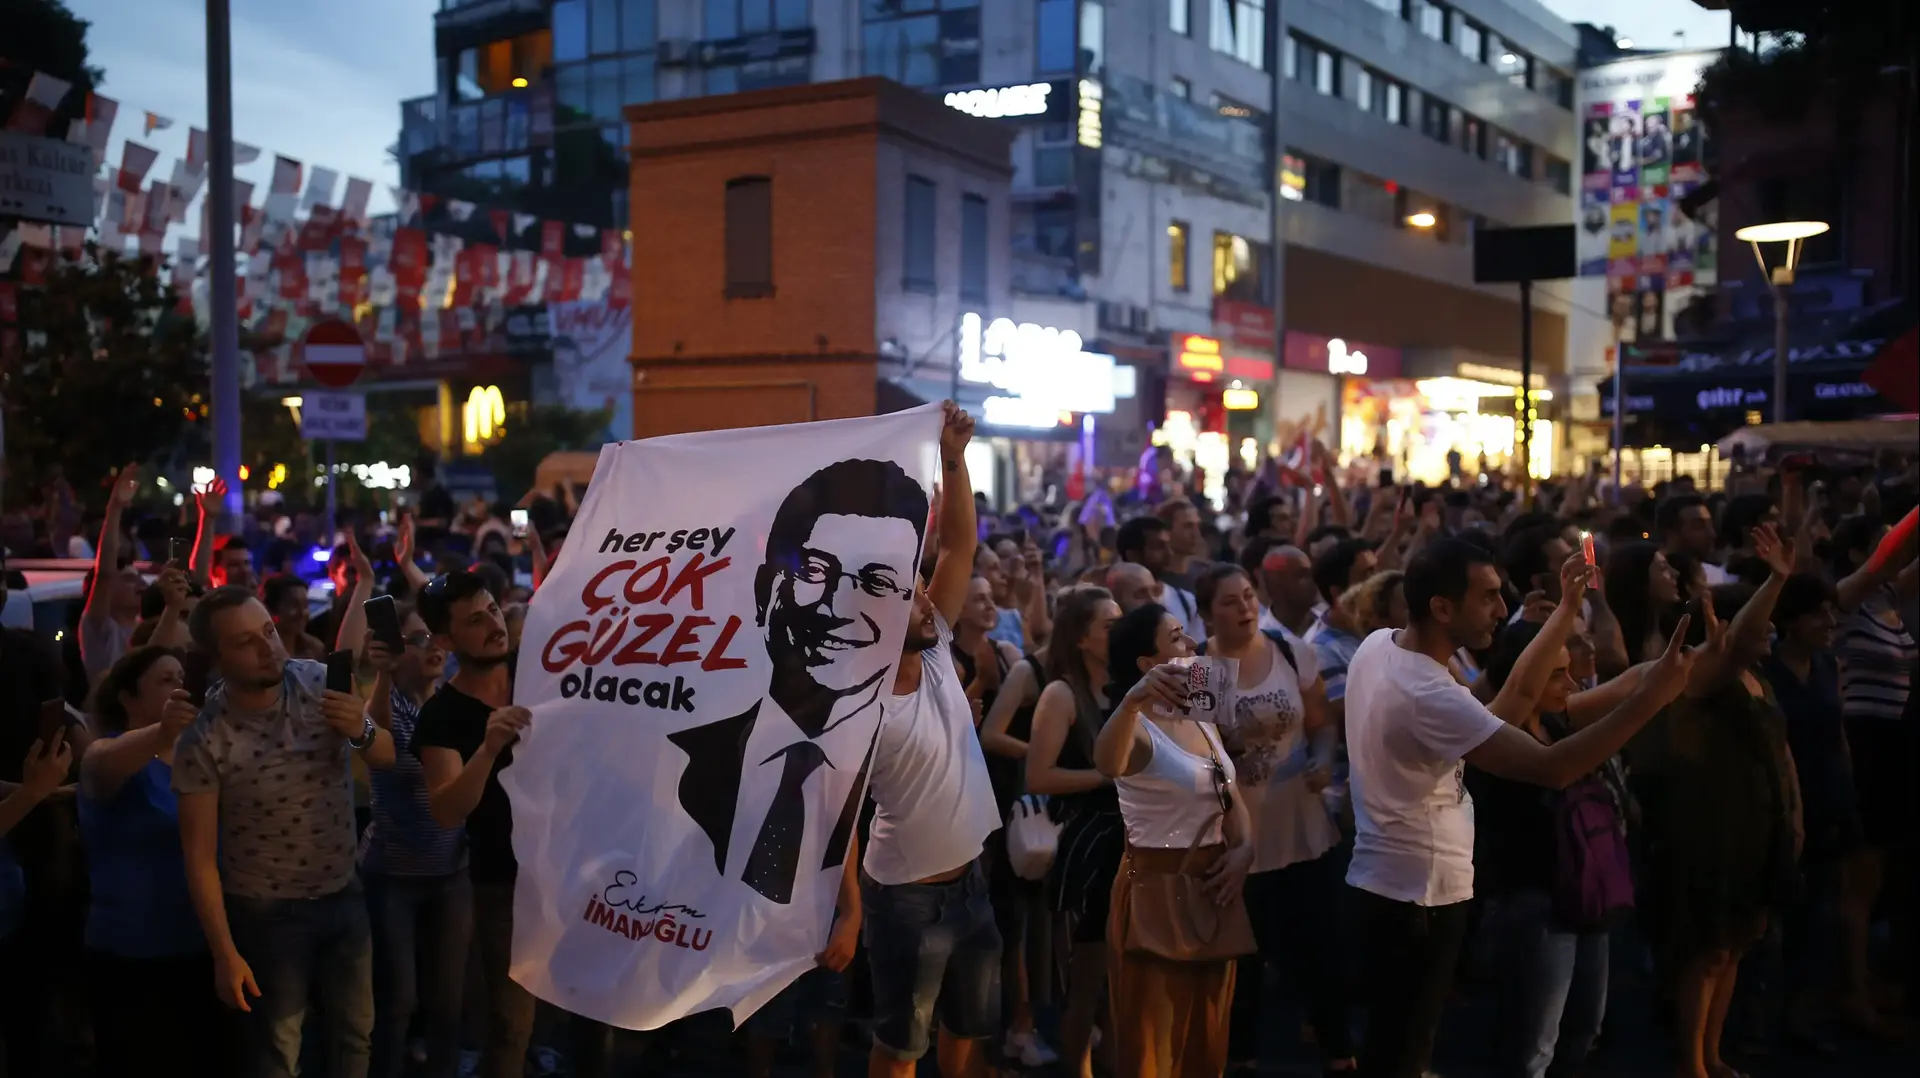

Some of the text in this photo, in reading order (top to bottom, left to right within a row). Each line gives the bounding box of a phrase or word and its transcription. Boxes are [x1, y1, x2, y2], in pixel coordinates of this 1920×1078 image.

[598, 527, 736, 557] her şey
[581, 552, 732, 615] ÇOK
[541, 606, 748, 673] GÜZEL
[560, 667, 696, 713] olacak
